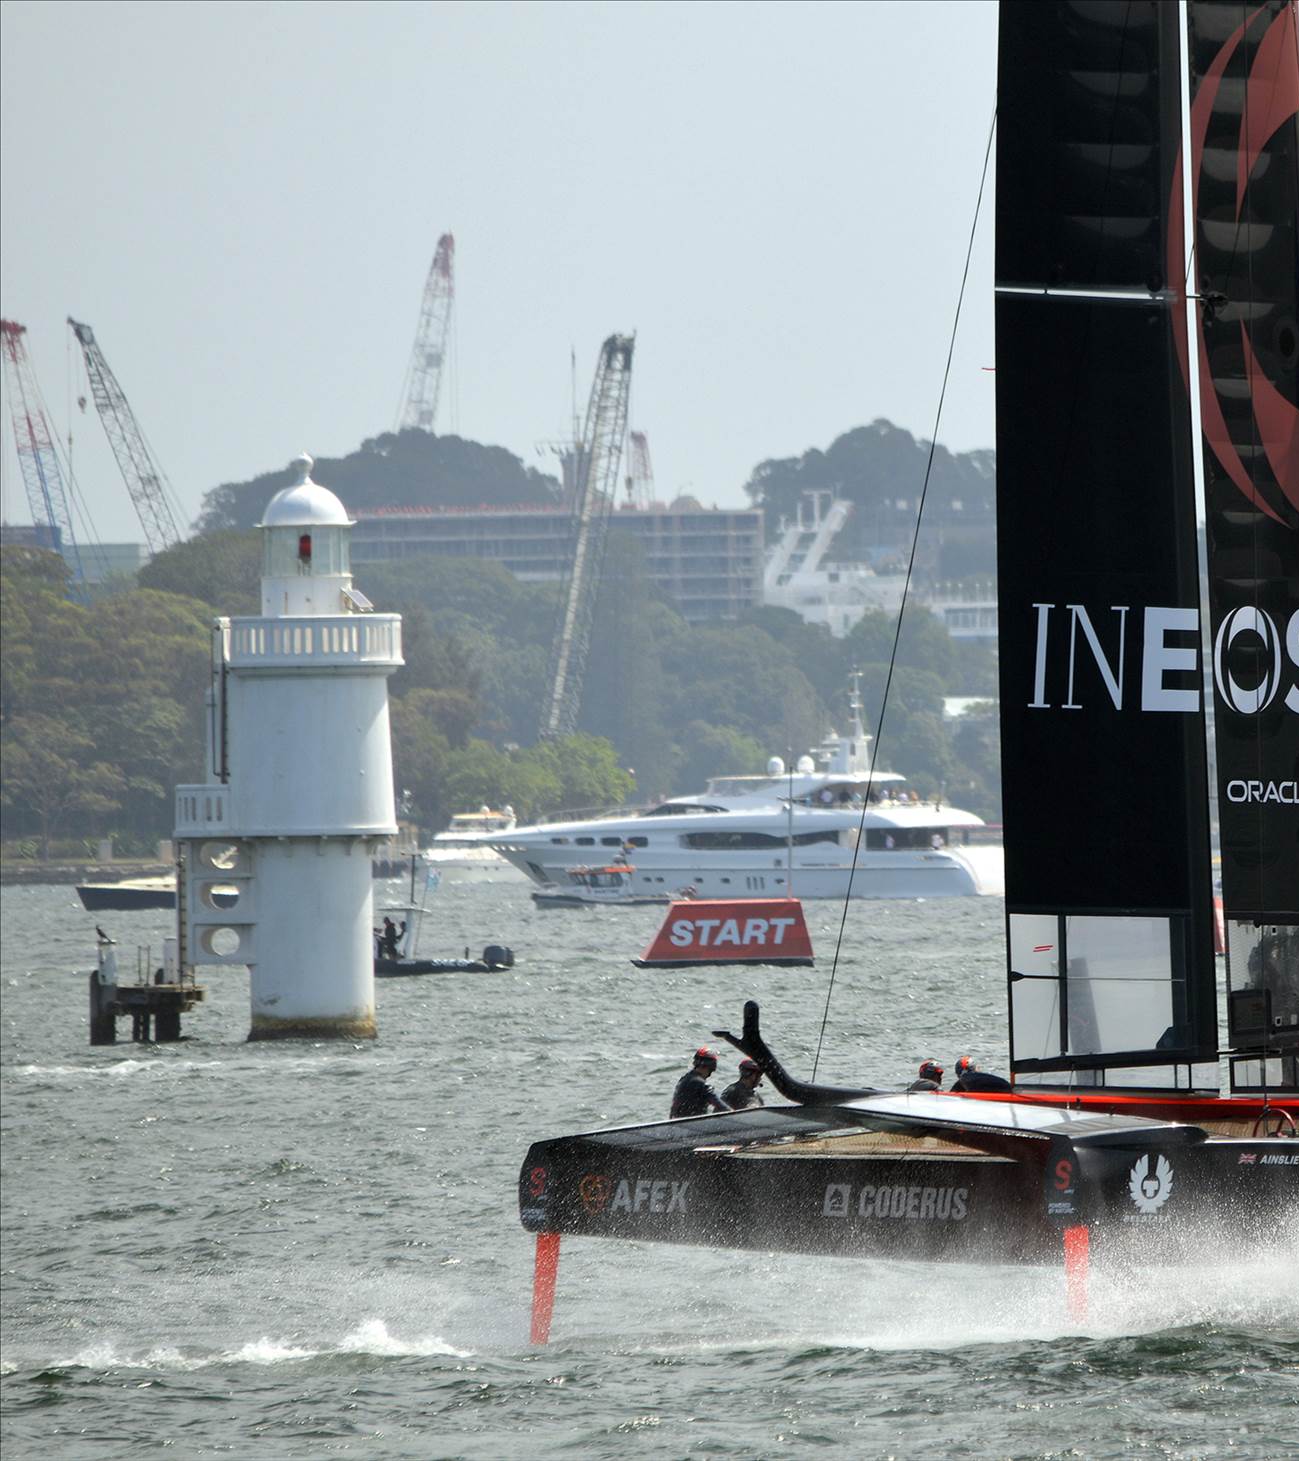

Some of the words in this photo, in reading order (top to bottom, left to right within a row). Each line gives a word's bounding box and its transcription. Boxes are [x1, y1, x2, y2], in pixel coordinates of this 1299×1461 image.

[669, 918, 795, 947] START
[610, 1179, 690, 1213] AFEX
[857, 1185, 969, 1220] CODERUS
